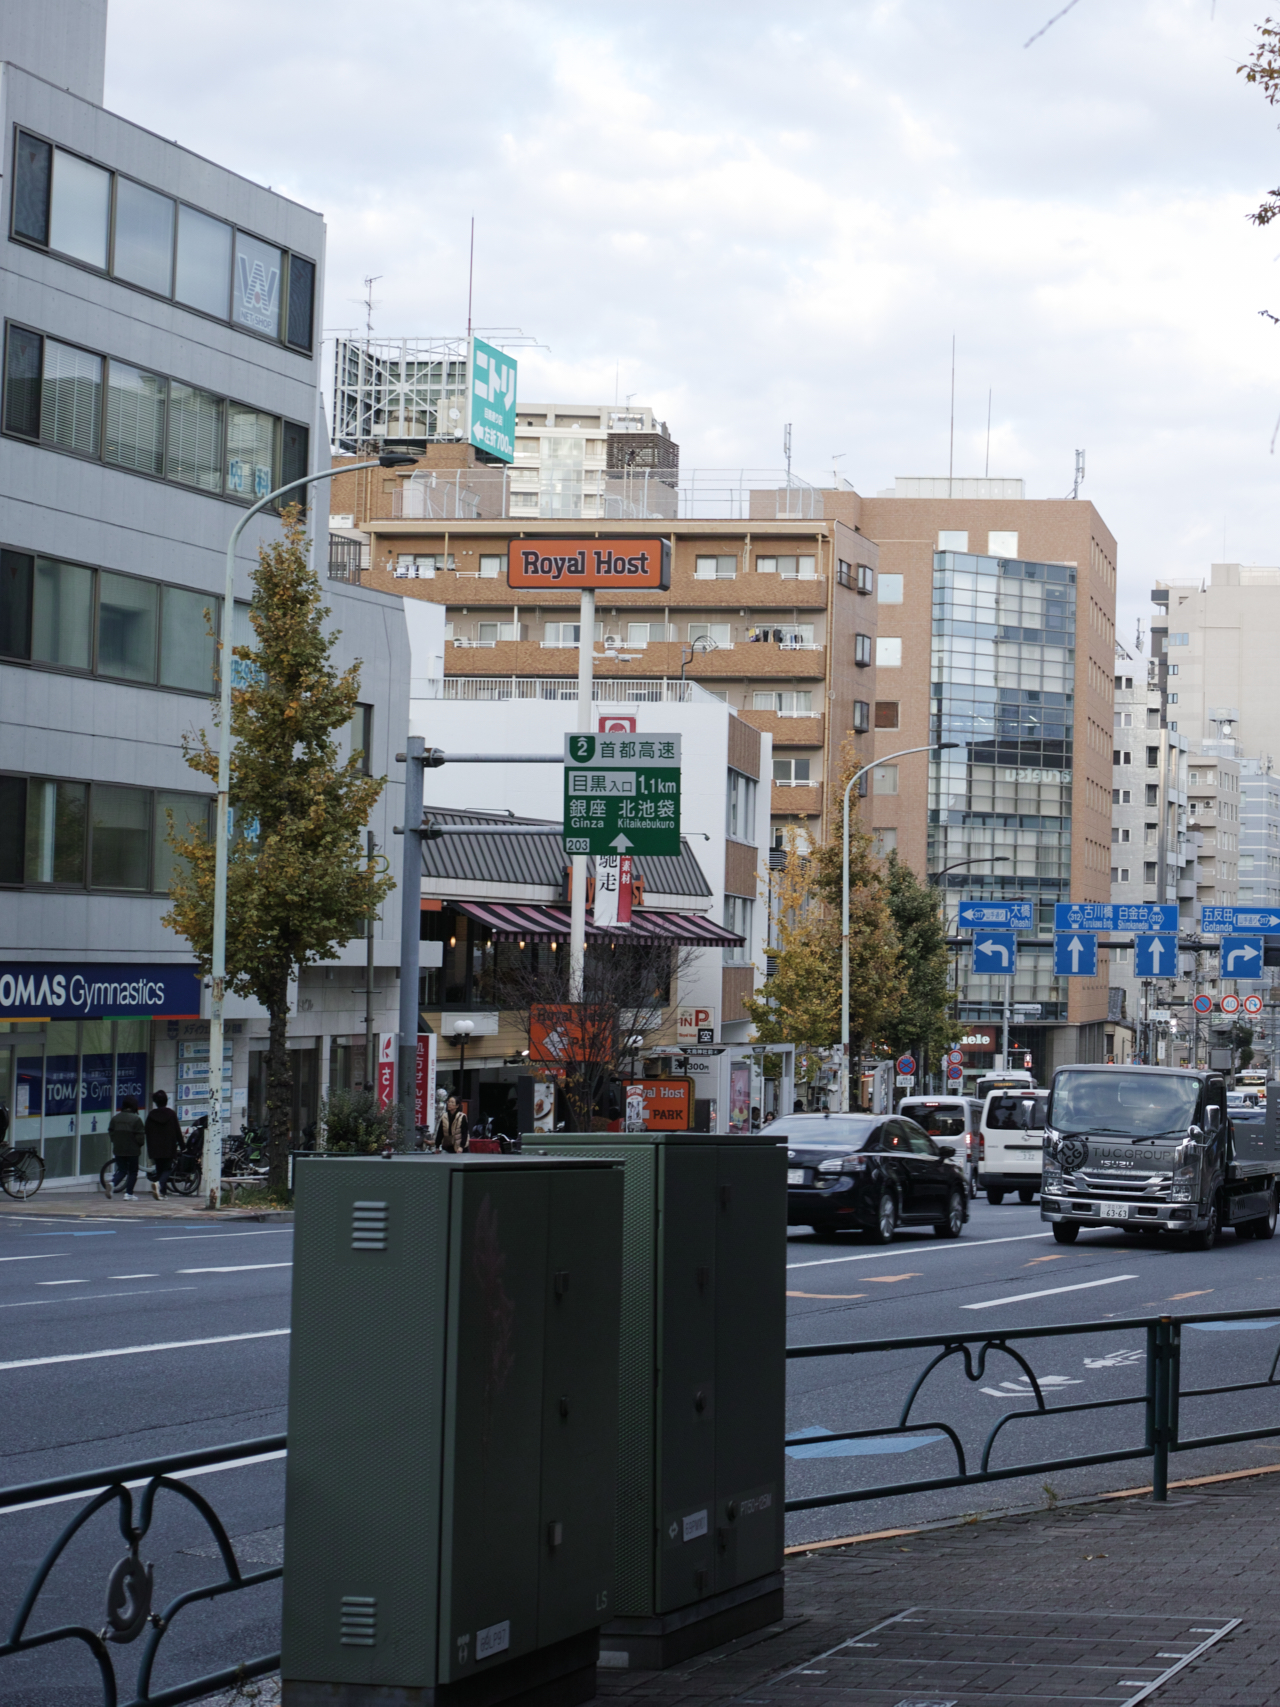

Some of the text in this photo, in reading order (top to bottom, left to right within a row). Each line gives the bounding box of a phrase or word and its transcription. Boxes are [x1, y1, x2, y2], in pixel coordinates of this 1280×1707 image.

[474, 350, 515, 412] ニトリ
[521, 550, 650, 580] Royal Host
[577, 741, 588, 756] 2
[600, 741, 675, 759] 首都高速
[573, 774, 677, 795] 目黒入口 1.1km
[569, 799, 675, 818] 銀座 北池袋
[571, 818, 675, 829] Ginza Kitaikebukuro
[567, 839, 588, 851] 203
[1010, 904, 1031, 918] 大橋
[1084, 905, 1113, 918] 古川橋
[1119, 906, 1148, 920] 白金台
[1204, 908, 1233, 921] 五反田
[1010, 917, 1031, 928] Ohashi
[1204, 921, 1233, 932] Gotanda
[70, 975, 165, 1013] Gymnastics
[1224, 1000, 1236, 1009] 40
[680, 1017, 693, 1027] IN
[695, 1009, 710, 1027] P
[700, 1030, 712, 1042] 空
[950, 1053, 961, 1061] 50
[660, 1087, 685, 1098] Host
[652, 1109, 684, 1120] PARK
[1092, 1147, 1171, 1160] T.U.C.GROUP
[1101, 1160, 1134, 1168] ISUZU
[1106, 1209, 1127, 1218] 63-63
[596, 1590, 608, 1611] LS
